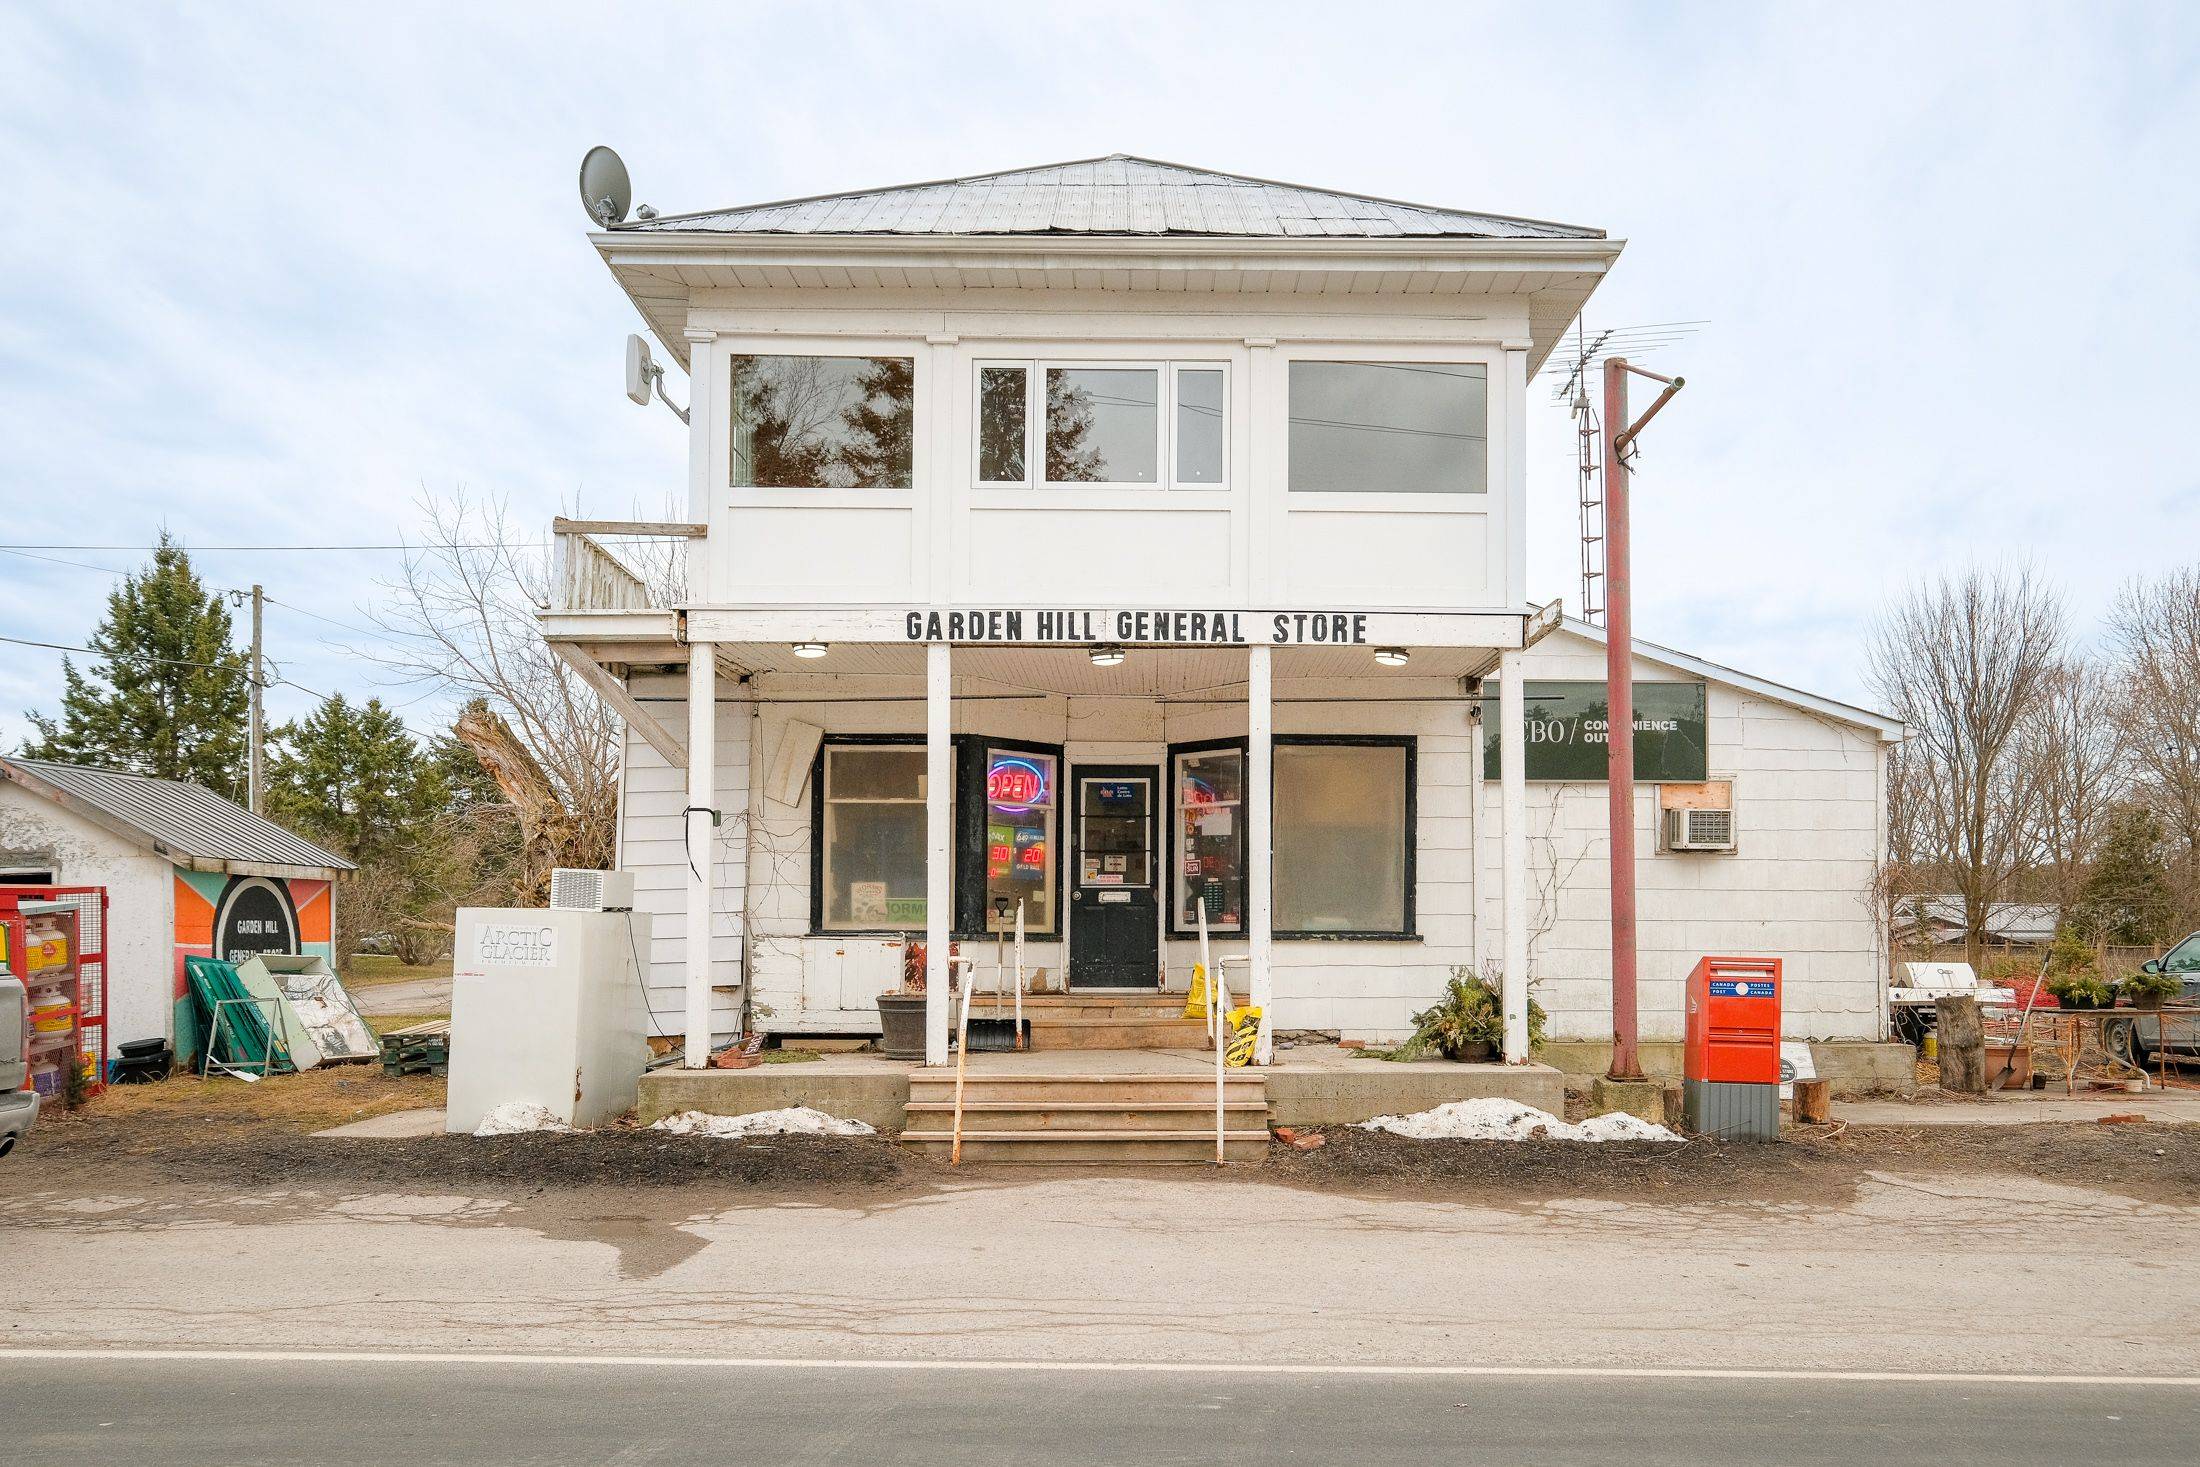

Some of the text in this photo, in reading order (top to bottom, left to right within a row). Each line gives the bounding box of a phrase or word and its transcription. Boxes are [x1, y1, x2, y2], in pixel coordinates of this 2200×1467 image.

[906, 611, 1367, 644] GARDEN HILL GENERAL STORE
[1583, 720, 1678, 731] CONNIENCE
[988, 773, 1038, 799] OPEN
[992, 846, 1008, 861] 30
[1024, 848, 1041, 863] 20
[237, 920, 279, 934] GARDEN HILL
[480, 925, 553, 947] ARCTIC
[481, 945, 551, 961] GLACIER
